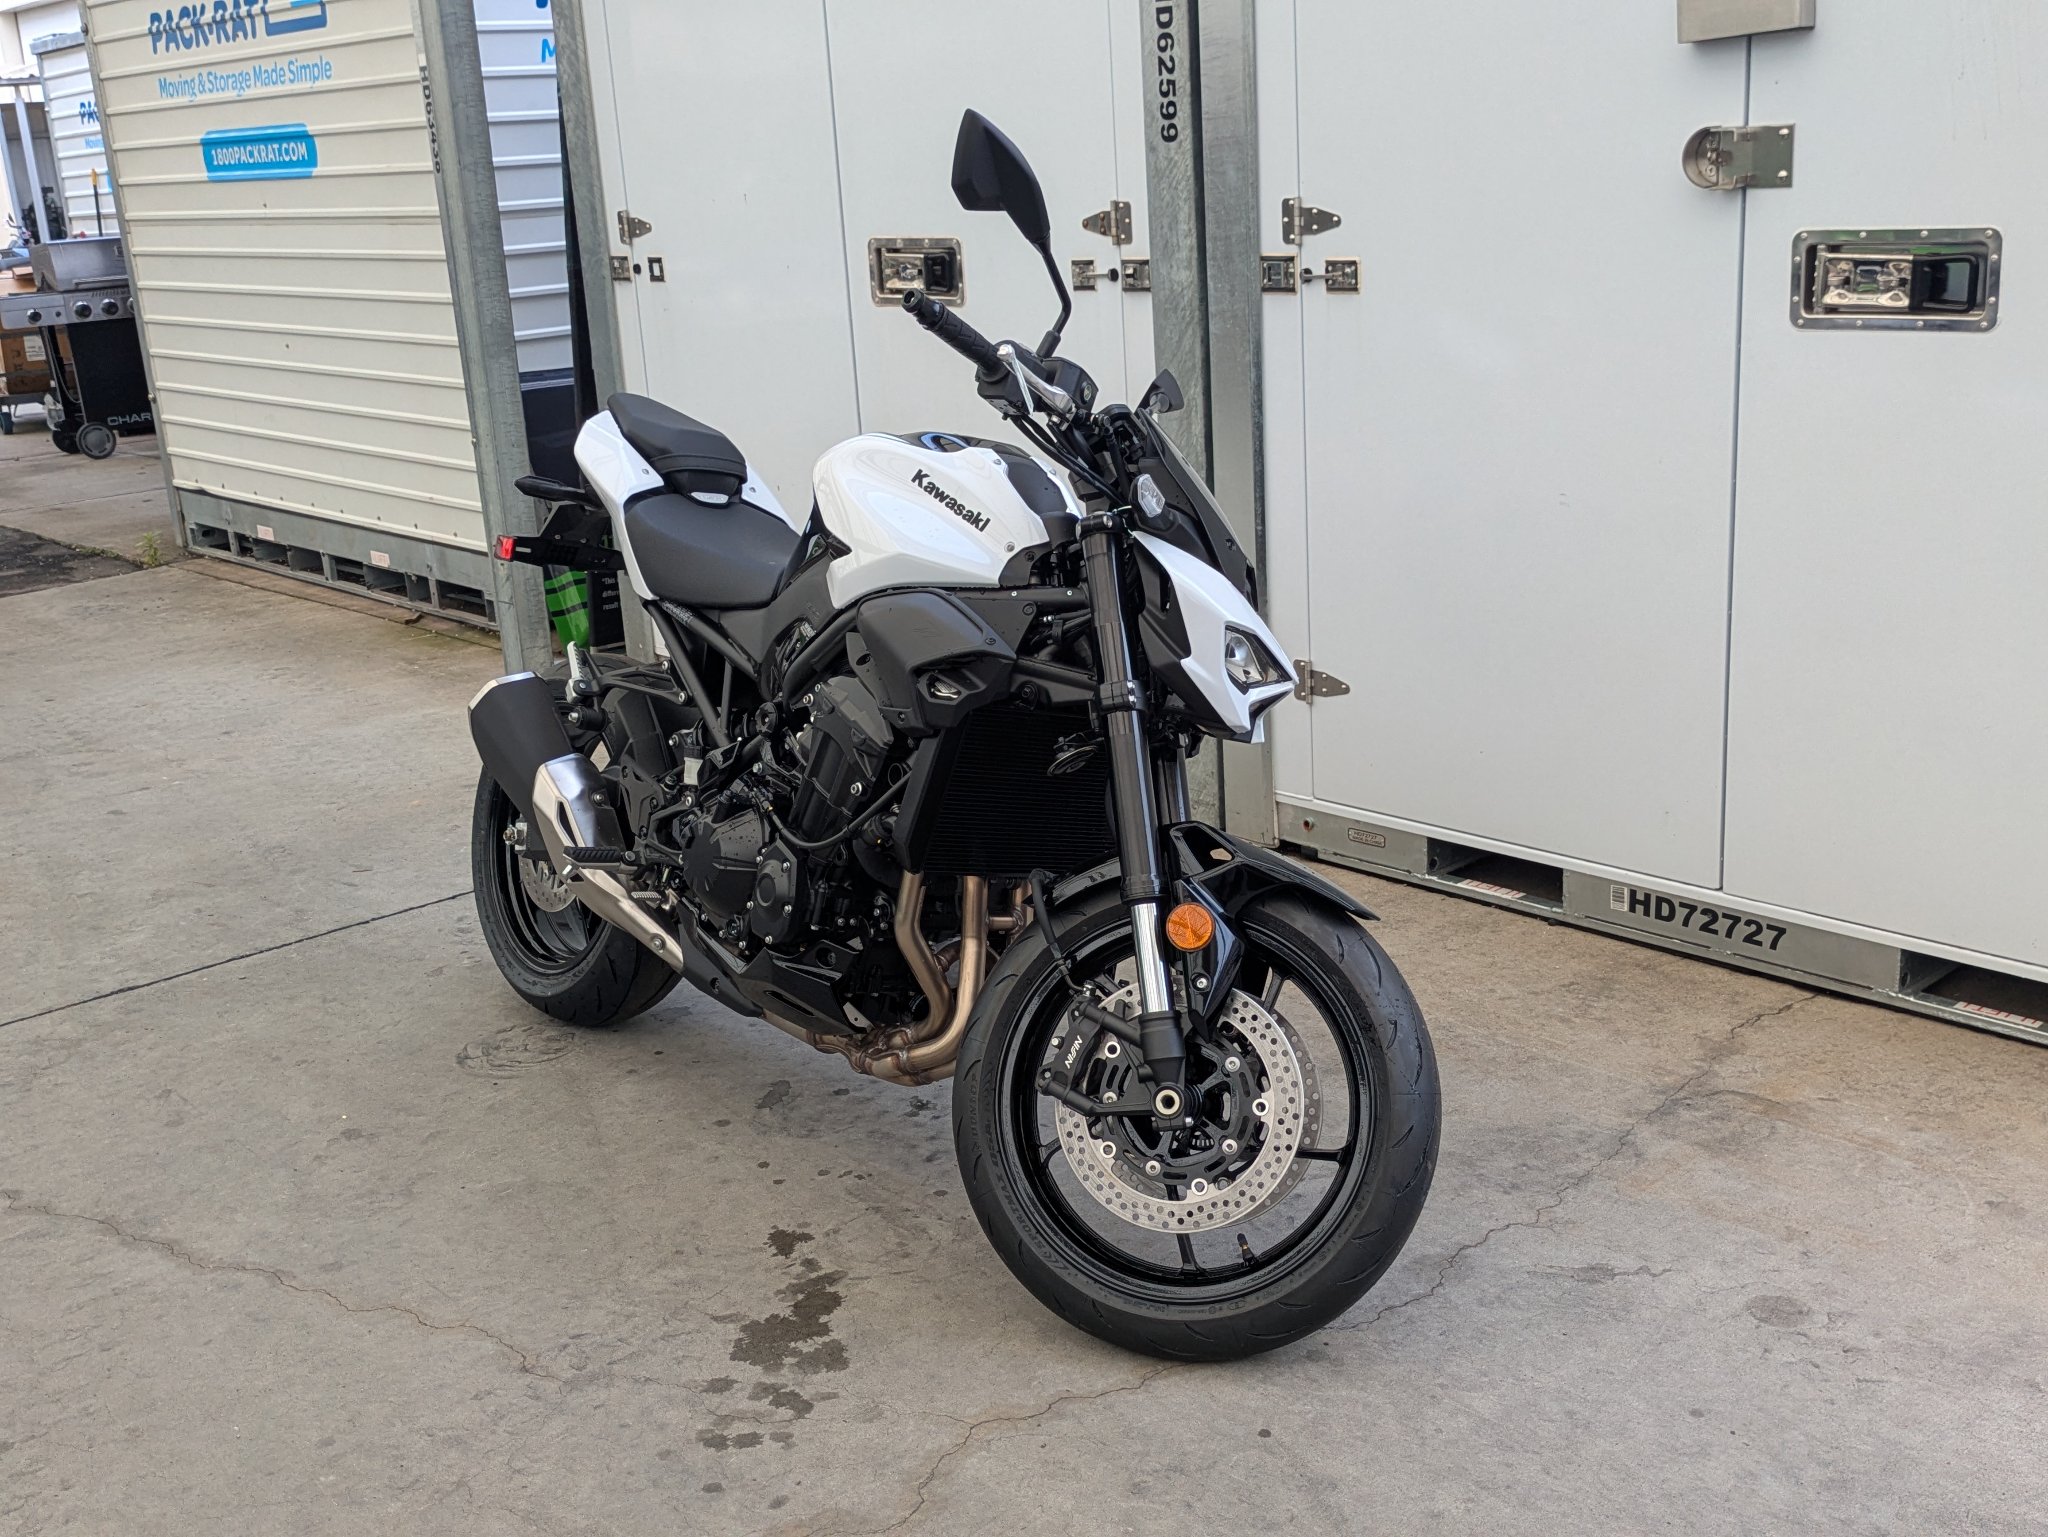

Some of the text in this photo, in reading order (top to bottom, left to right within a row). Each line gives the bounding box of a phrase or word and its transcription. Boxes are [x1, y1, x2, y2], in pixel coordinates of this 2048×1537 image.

[158, 55, 332, 102] Moving & Storage Made Simple
[1155, 0, 1179, 143] D62599
[211, 142, 308, 166] 1800PACKRAT.COM
[911, 468, 991, 533] Kawasaki
[1629, 889, 1787, 950] HD72727
